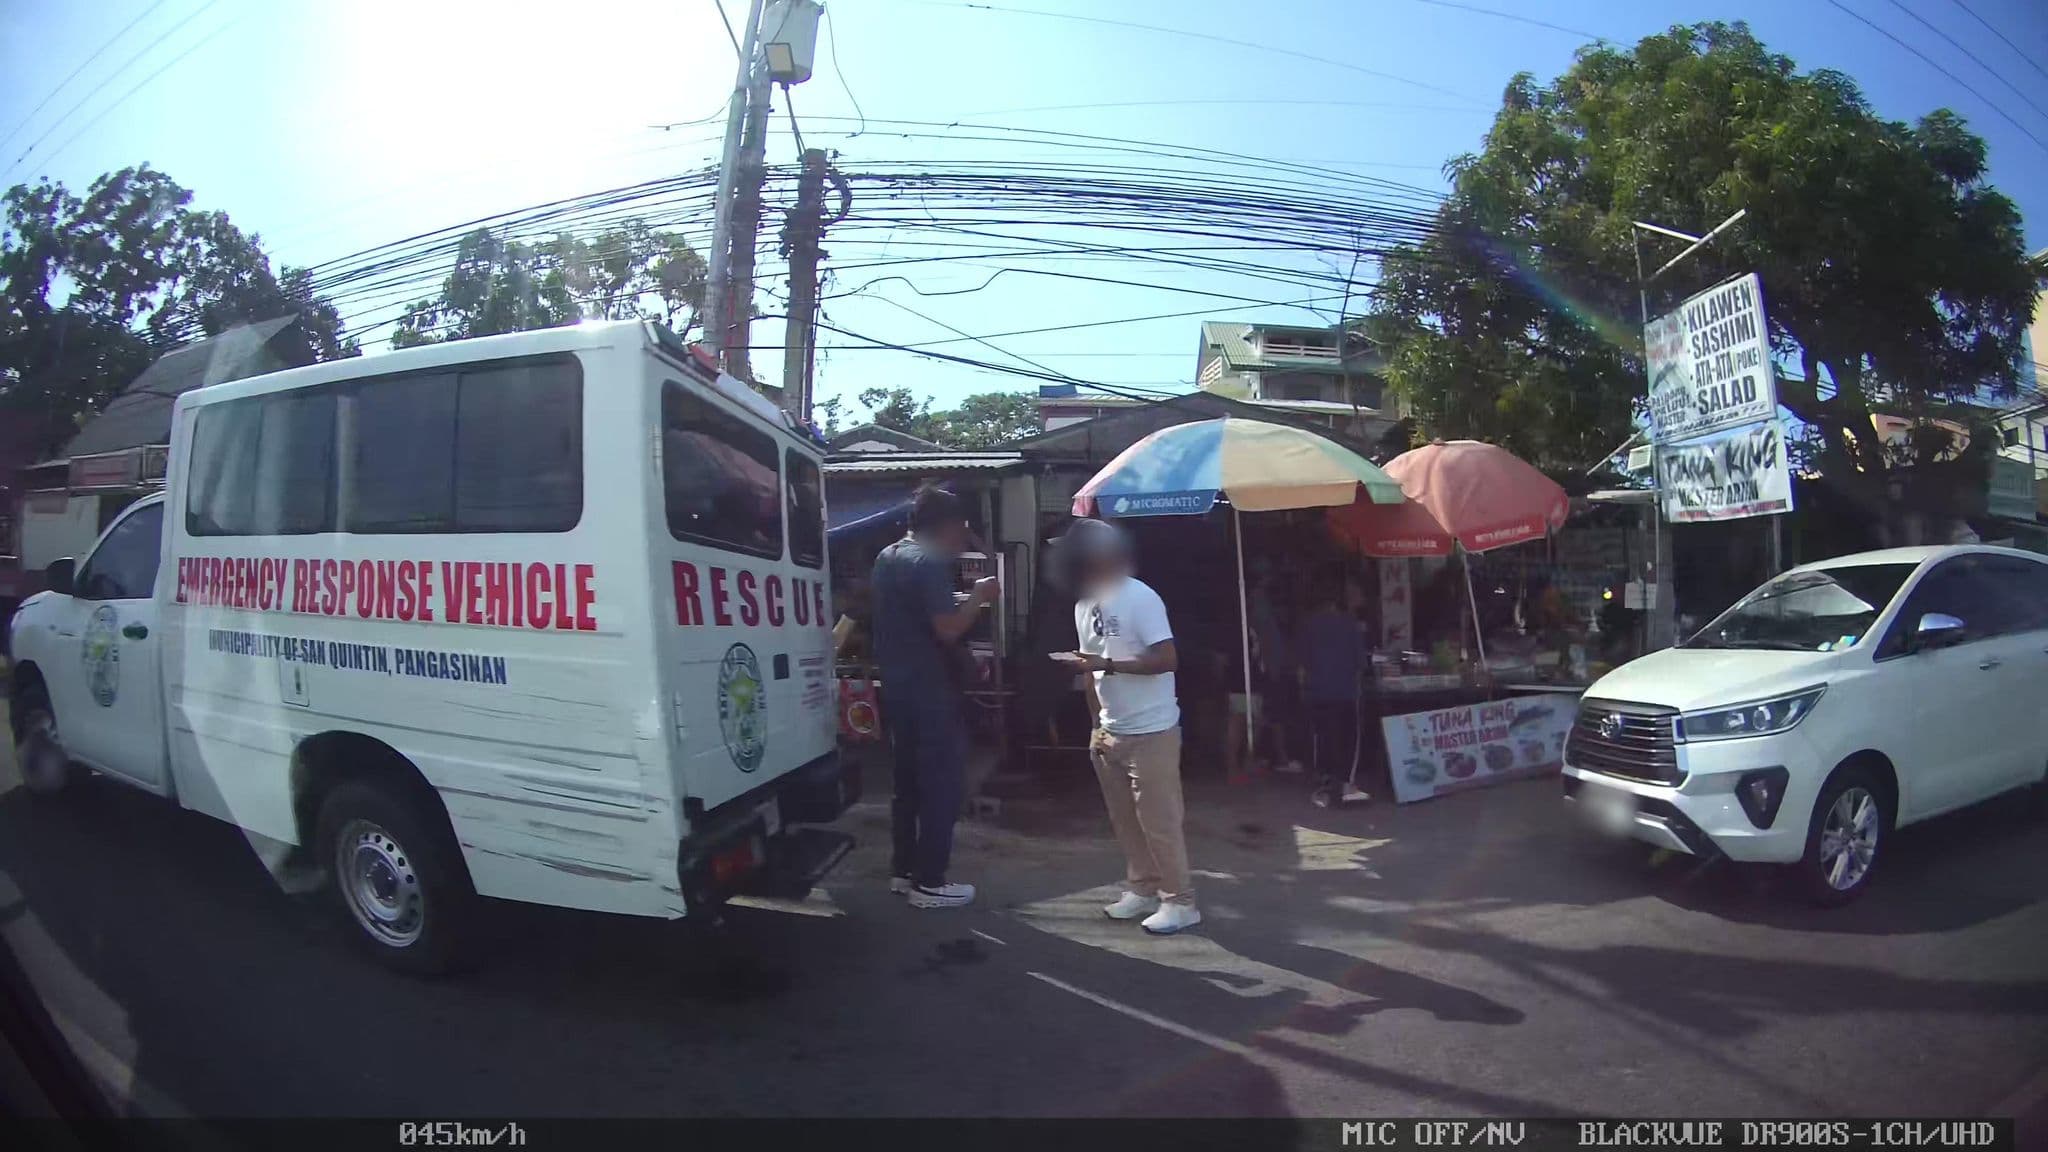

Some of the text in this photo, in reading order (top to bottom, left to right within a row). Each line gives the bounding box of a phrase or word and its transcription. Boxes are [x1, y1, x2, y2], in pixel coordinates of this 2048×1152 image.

[1687, 281, 1752, 333] KILAWEN
[1691, 311, 1757, 360] SASHIMI
[1695, 351, 1734, 389] ATA-ATA
[1698, 375, 1757, 415] SALAD
[1132, 496, 1201, 510] MICROMATIC
[176, 557, 597, 630] EMERGENCY RESPONSE VEHICLE
[672, 560, 825, 627] RESCUE
[209, 629, 280, 658] MUNICIPALITY
[284, 636, 298, 661] OF
[299, 638, 326, 665] SAN
[395, 648, 508, 685] PANGASINAN
